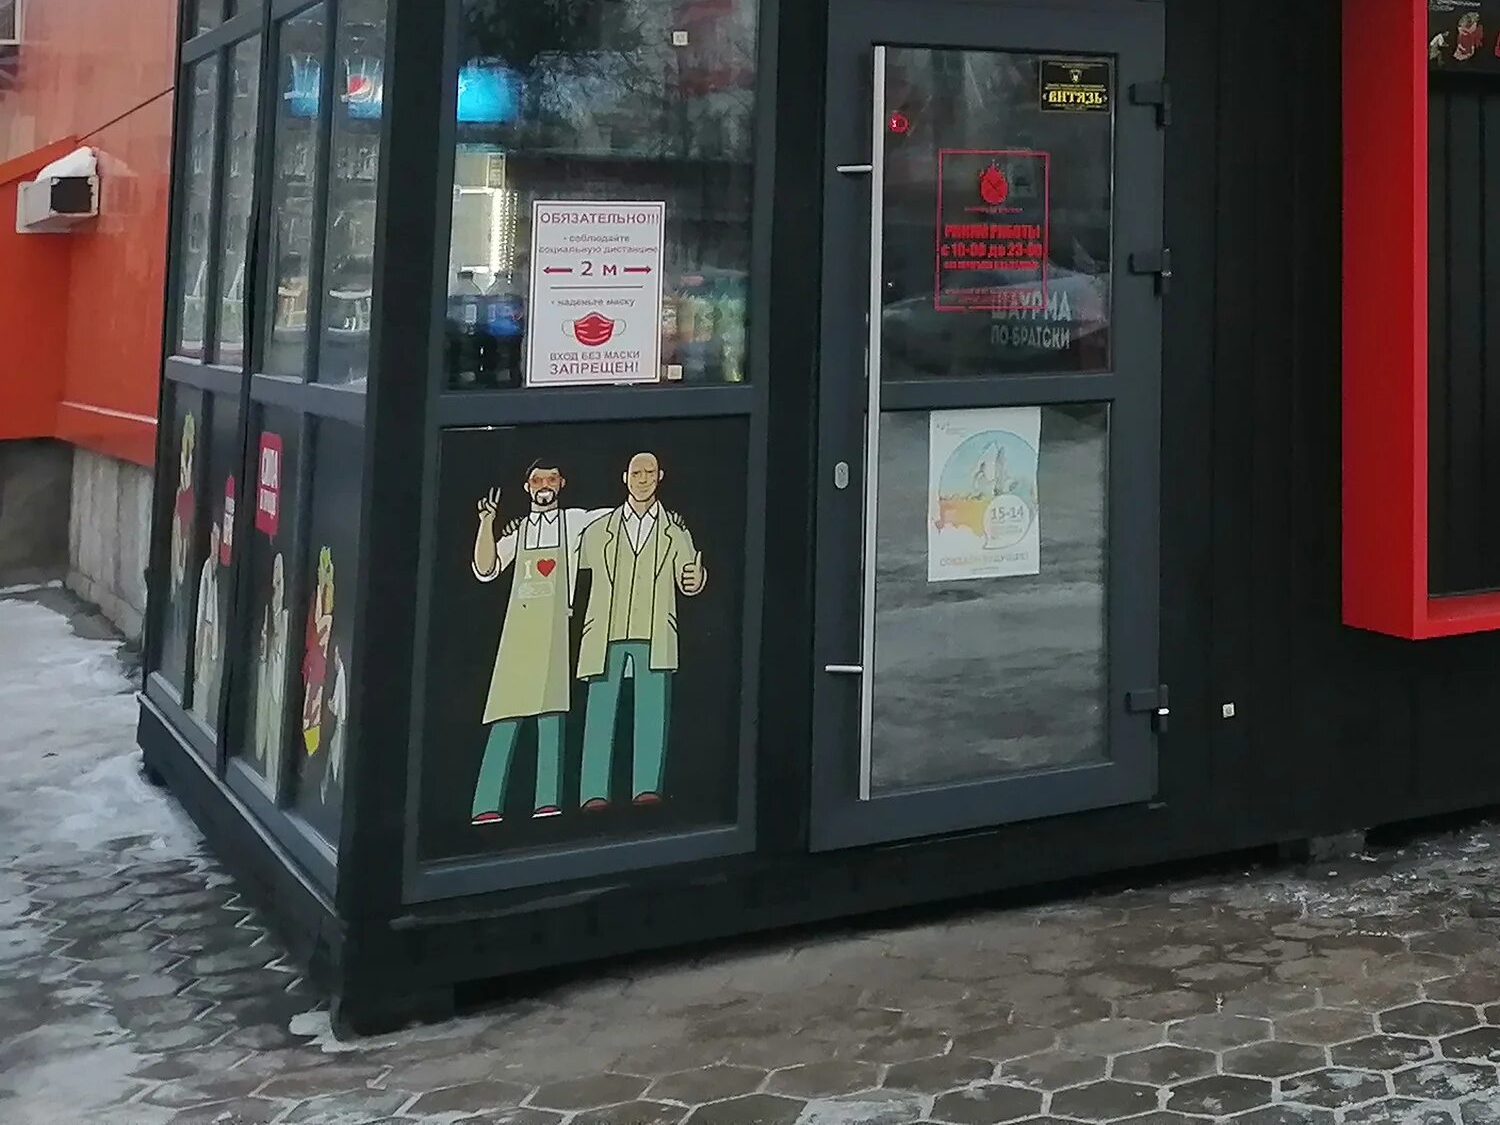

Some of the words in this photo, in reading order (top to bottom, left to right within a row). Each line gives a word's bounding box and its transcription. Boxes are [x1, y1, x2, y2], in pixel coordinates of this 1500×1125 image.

[540, 212, 659, 224] ОБЯЗАТЕЛЬНО!!!
[581, 261, 593, 276] 2
[549, 351, 579, 362] ВХОД
[604, 350, 640, 361] МАСКИ
[549, 361, 640, 376] ЗАПРЕЩЕН!
